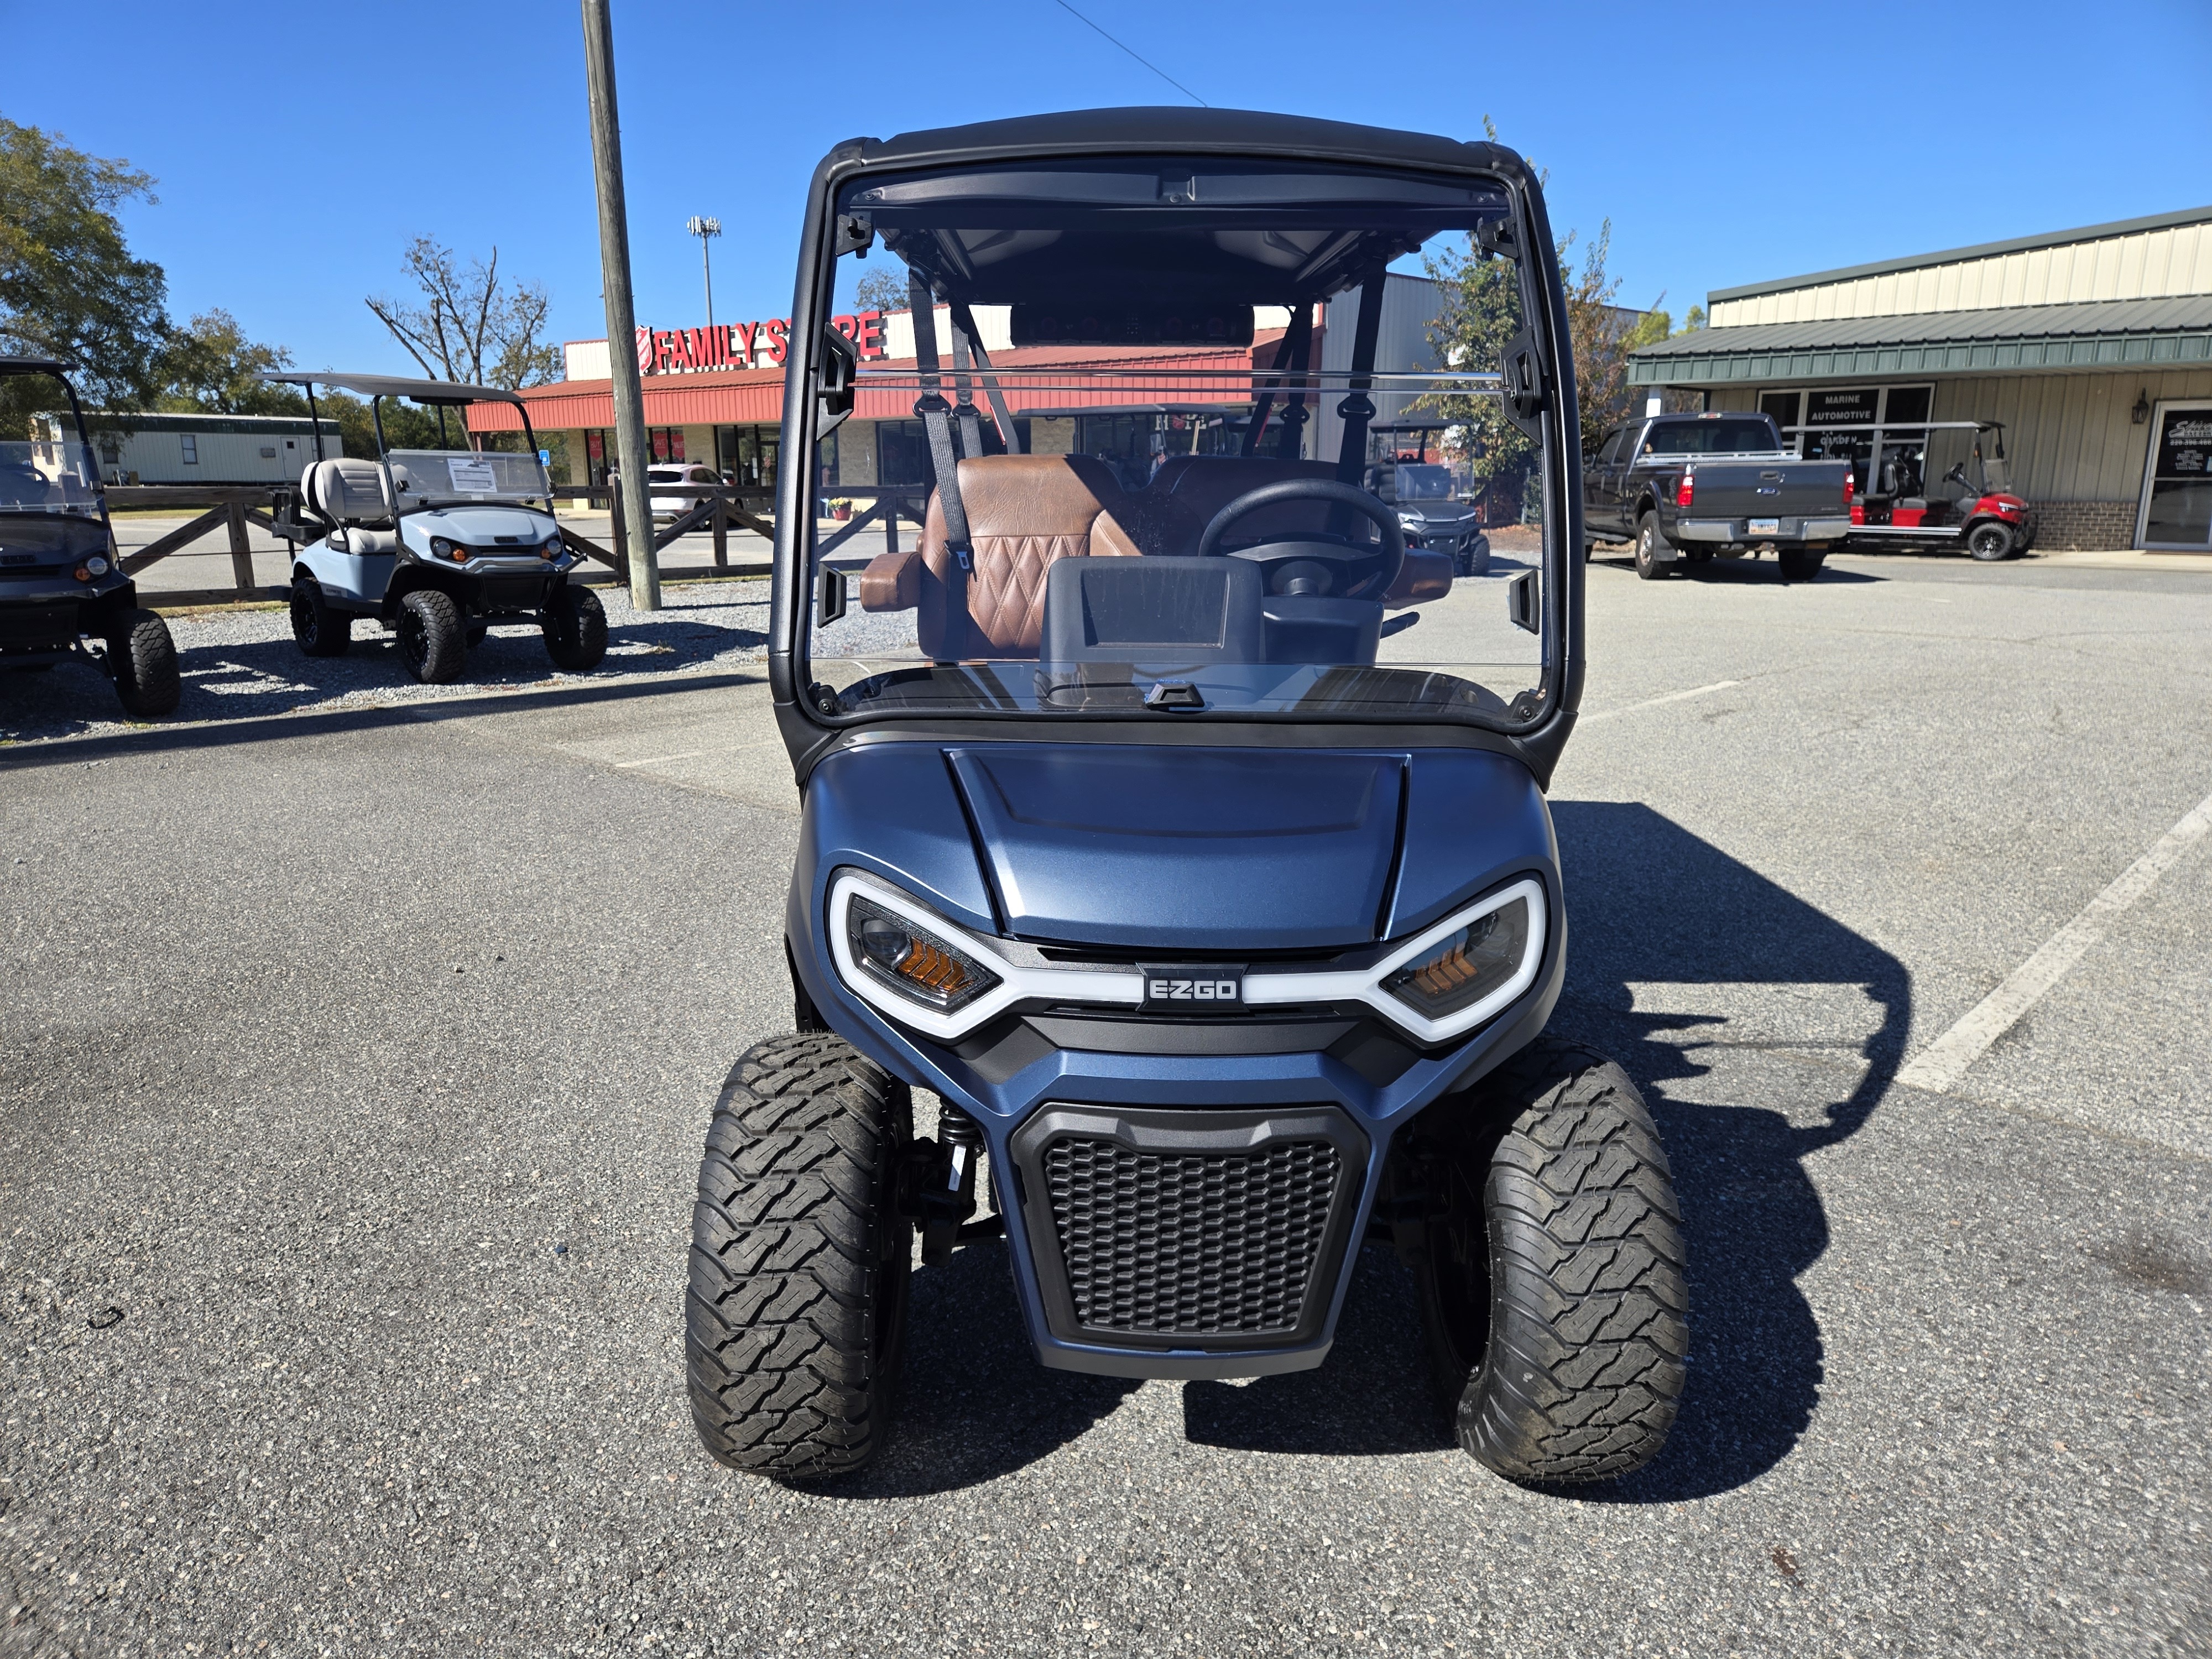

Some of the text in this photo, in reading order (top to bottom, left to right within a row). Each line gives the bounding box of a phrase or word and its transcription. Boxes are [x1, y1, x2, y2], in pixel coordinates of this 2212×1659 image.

[654, 321, 758, 370] FAMILY
[1825, 394, 1860, 404] MARINE
[1812, 410, 1871, 420] AUTOMOTIVE
[1150, 980, 1237, 999] EZGO
